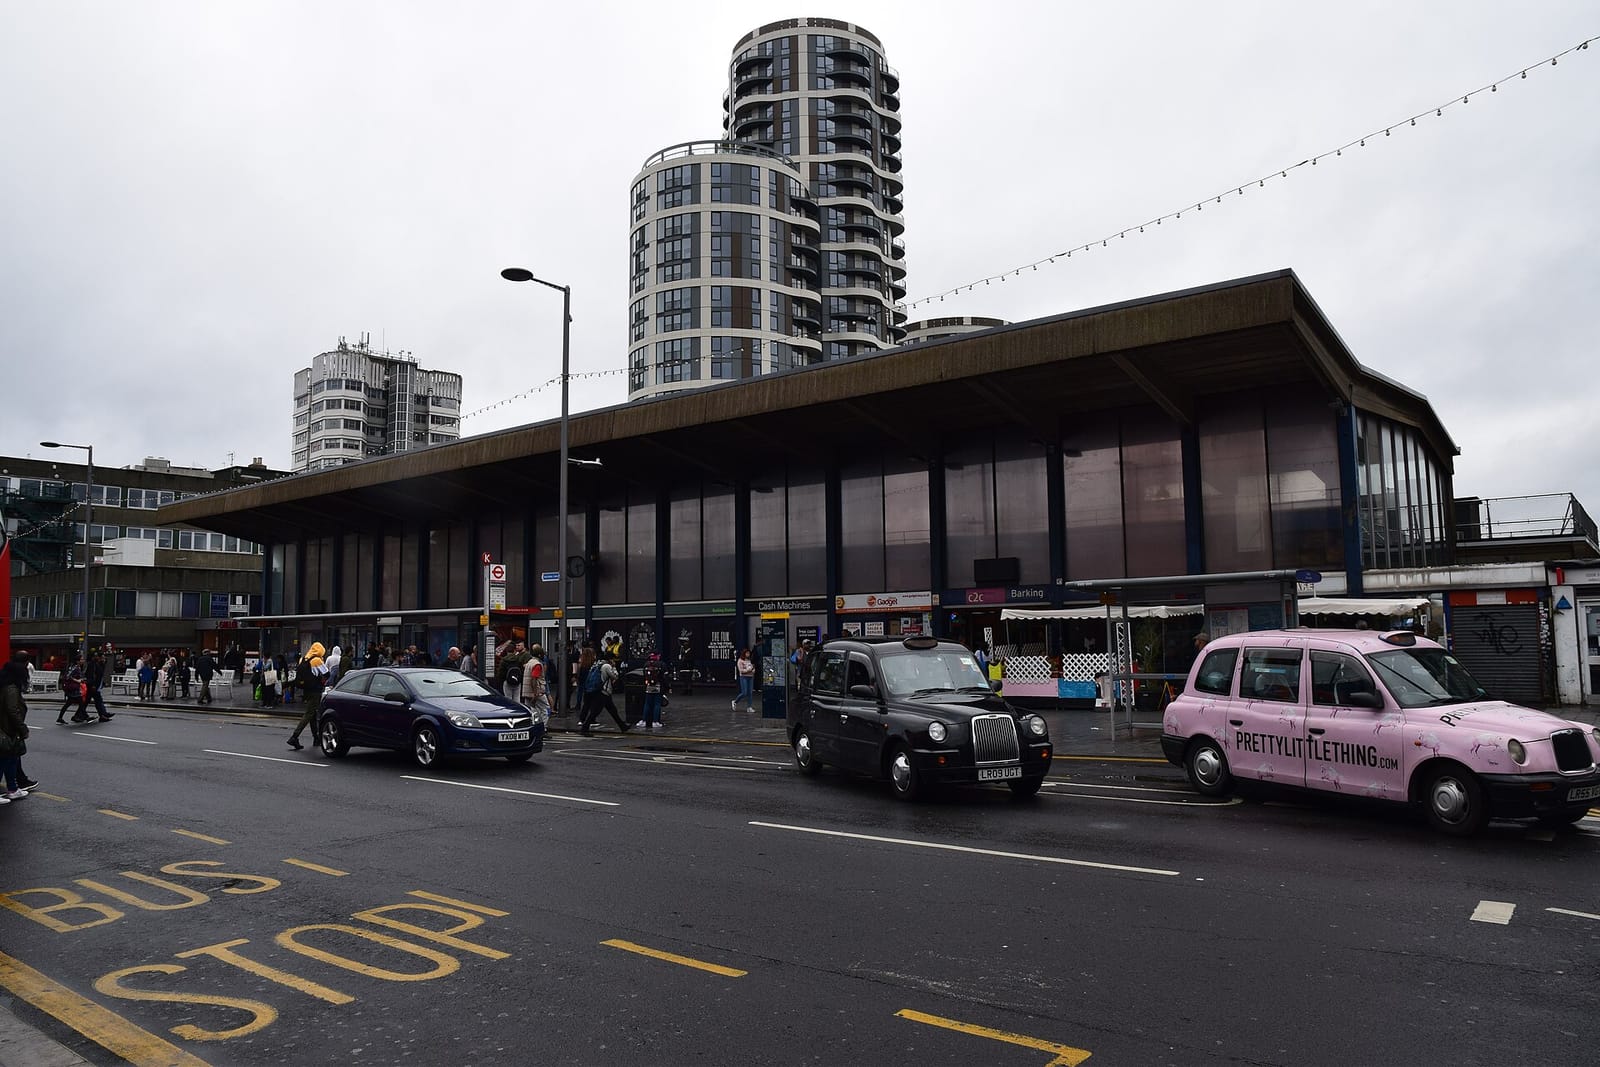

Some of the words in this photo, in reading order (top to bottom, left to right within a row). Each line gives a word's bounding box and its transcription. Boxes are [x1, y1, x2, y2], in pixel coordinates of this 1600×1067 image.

[484, 554, 490, 563] K
[968, 592, 984, 602] c2c
[1010, 589, 1044, 599] Barking
[758, 602, 776, 611] Cash
[777, 600, 810, 610] Machines
[877, 598, 898, 606] Gadget
[982, 769, 1002, 779] LR09
[0, 860, 282, 934] BUS
